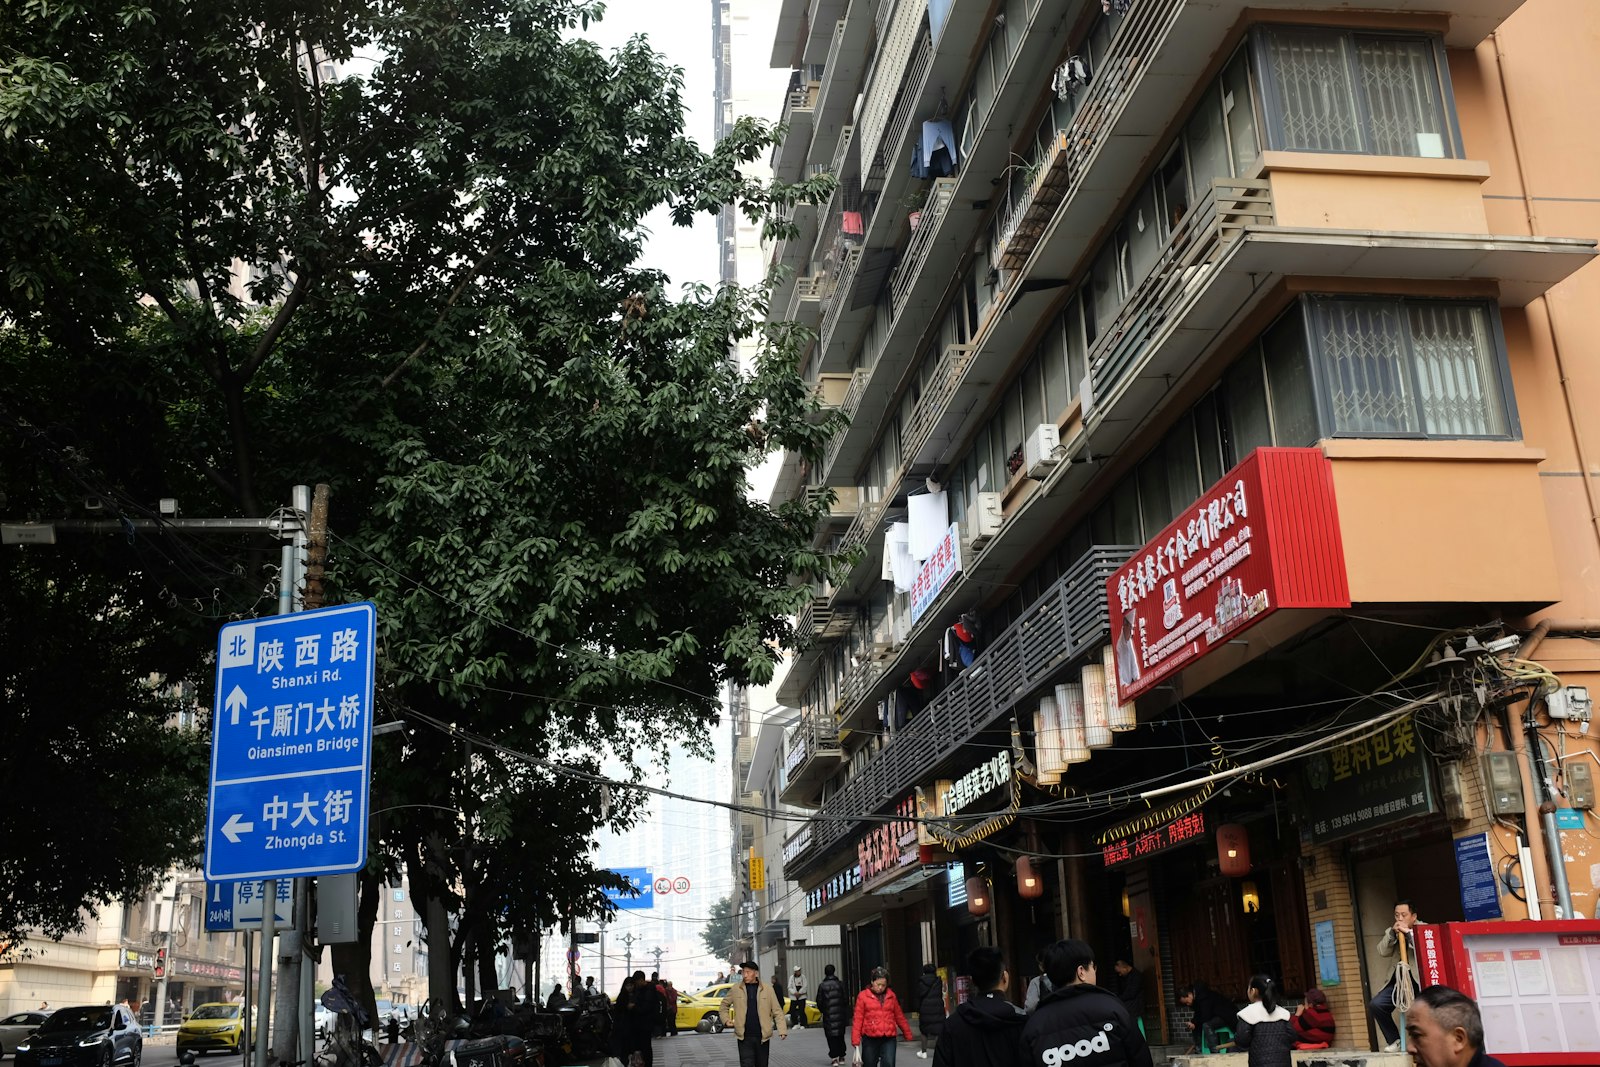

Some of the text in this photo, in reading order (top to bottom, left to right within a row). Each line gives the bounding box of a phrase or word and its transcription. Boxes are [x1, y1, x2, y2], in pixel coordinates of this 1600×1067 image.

[229, 635, 247, 657] 北
[257, 628, 359, 674] 陕西路
[271, 668, 342, 690] Shanxi Rd.
[249, 693, 360, 741] 千厮门大桥
[247, 735, 359, 761] Qiansimen Bridge
[1330, 714, 1416, 782] 塑料包装
[262, 789, 353, 832] 中大街
[264, 829, 347, 851] Zhongda St.
[676, 881, 687, 890] 30
[209, 909, 231, 923] 24小时
[1424, 930, 1440, 986] 故意毁坏公私
[1042, 1031, 1110, 1067] good
